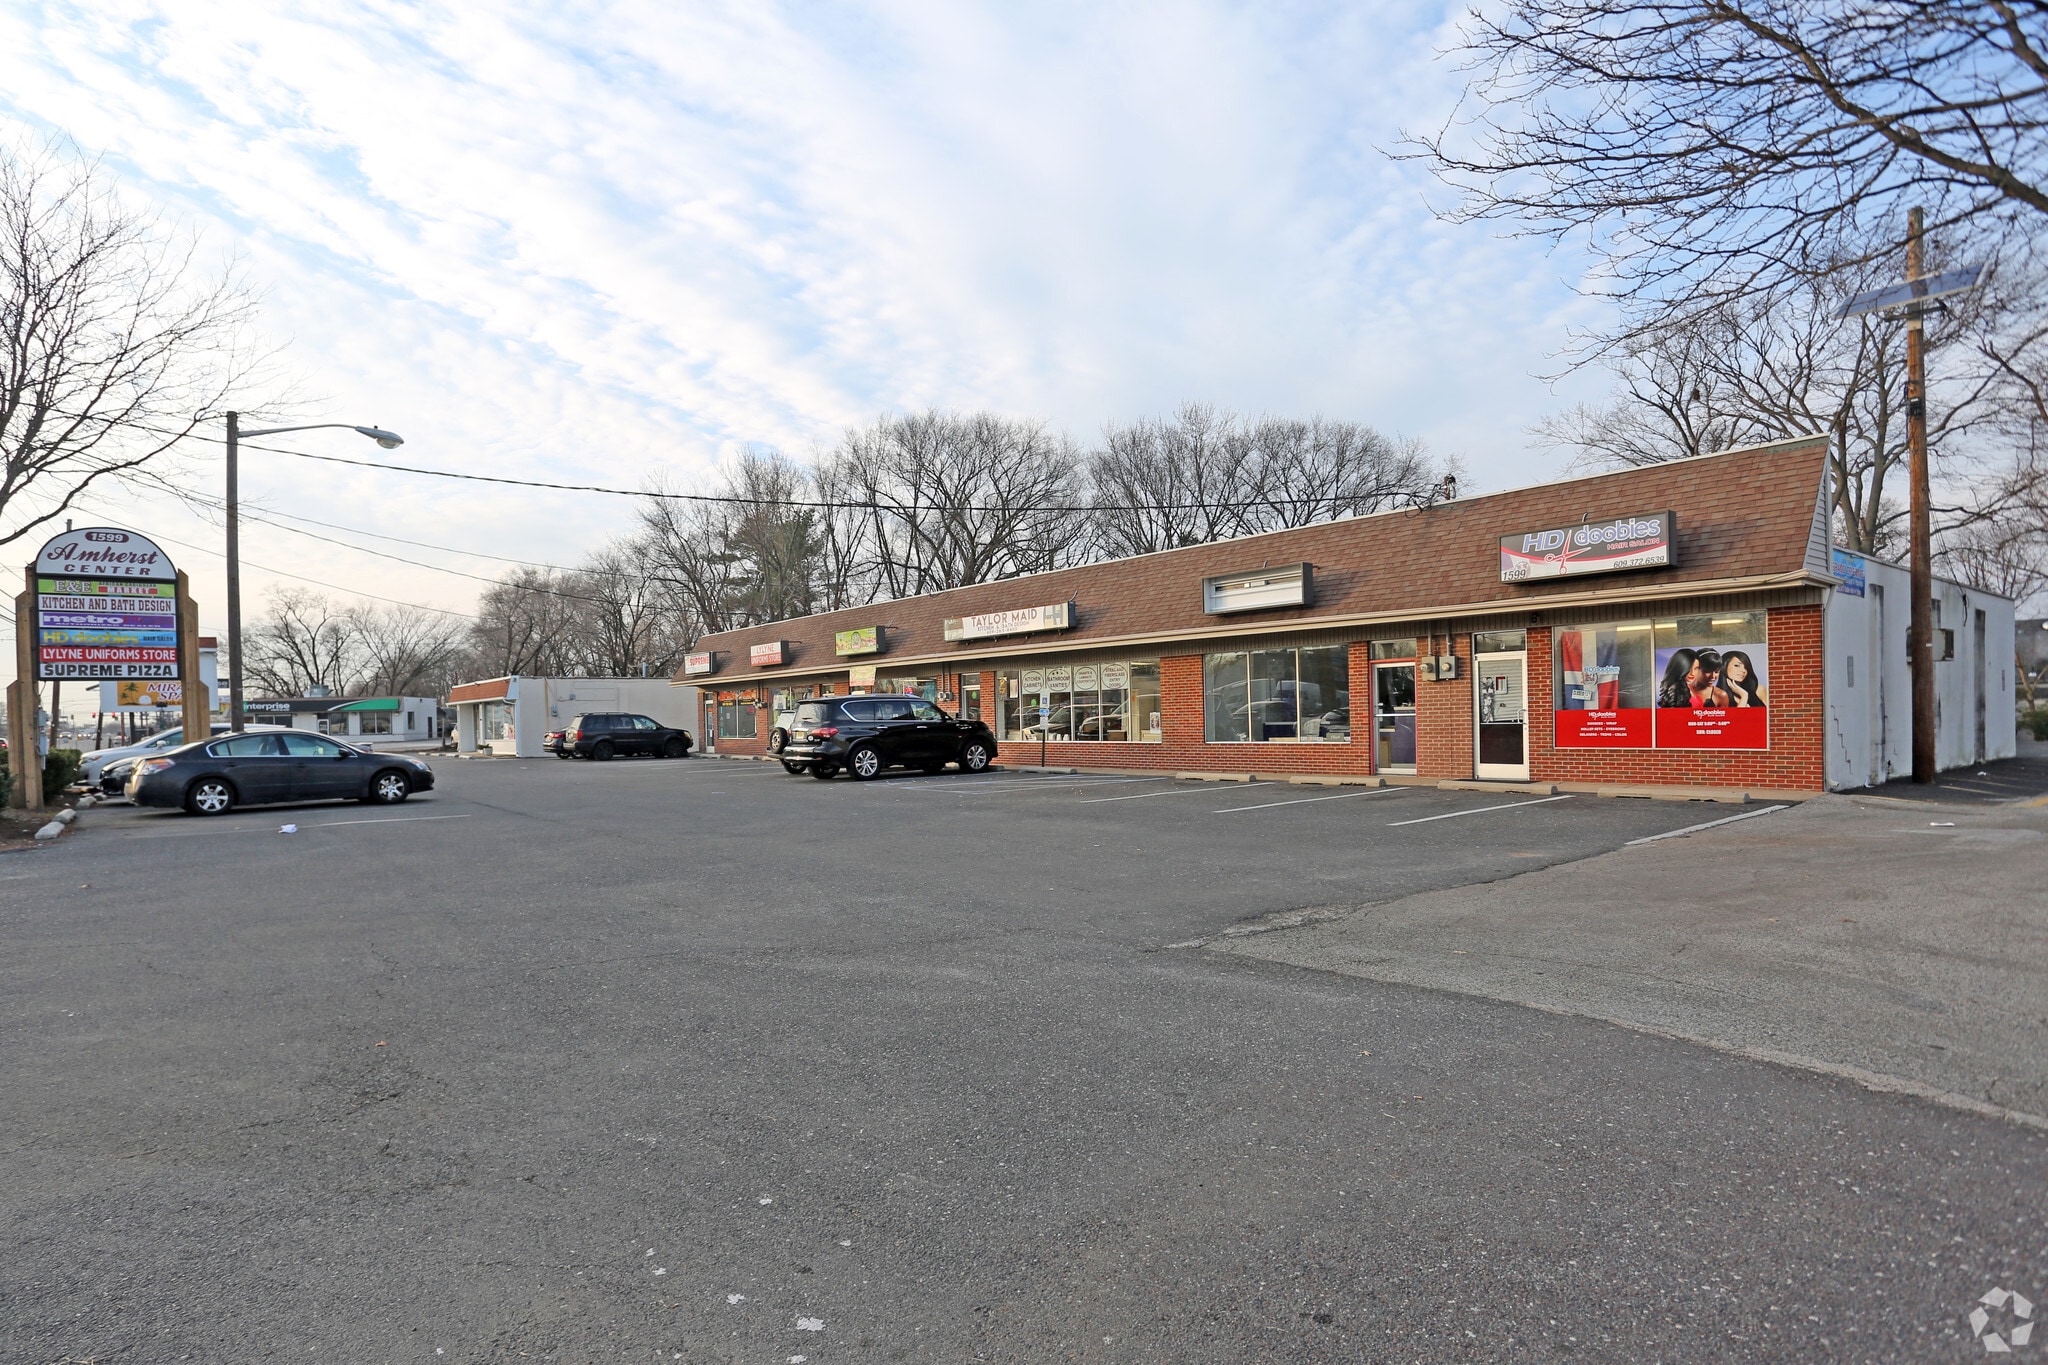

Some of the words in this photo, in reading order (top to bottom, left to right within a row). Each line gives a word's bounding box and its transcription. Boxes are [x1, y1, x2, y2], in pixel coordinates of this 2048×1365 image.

[91, 532, 124, 542] 1599
[1522, 530, 1565, 554] HD
[1575, 518, 1661, 546] doobies
[1606, 542, 1629, 551] HAIR
[1629, 537, 1660, 548] SALON
[47, 542, 159, 565] Amherst
[64, 564, 151, 576] CENTER
[1502, 568, 1527, 581] 1599
[55, 580, 92, 593] E&E
[107, 586, 149, 595] MARKET
[42, 597, 85, 610] KITCHEN
[89, 598, 108, 611] AND
[111, 599, 135, 612] BATH
[138, 600, 172, 613] DESIGN
[971, 613, 1008, 628] TAYLOR
[1011, 608, 1038, 623] MAID
[43, 631, 69, 643] HD
[72, 631, 140, 645] doobies
[43, 648, 83, 660] LYLYNE
[85, 649, 140, 660] UNIFORMS
[142, 649, 176, 660] STORE
[44, 662, 123, 676] SUPREME
[128, 664, 173, 676] PIZZA
